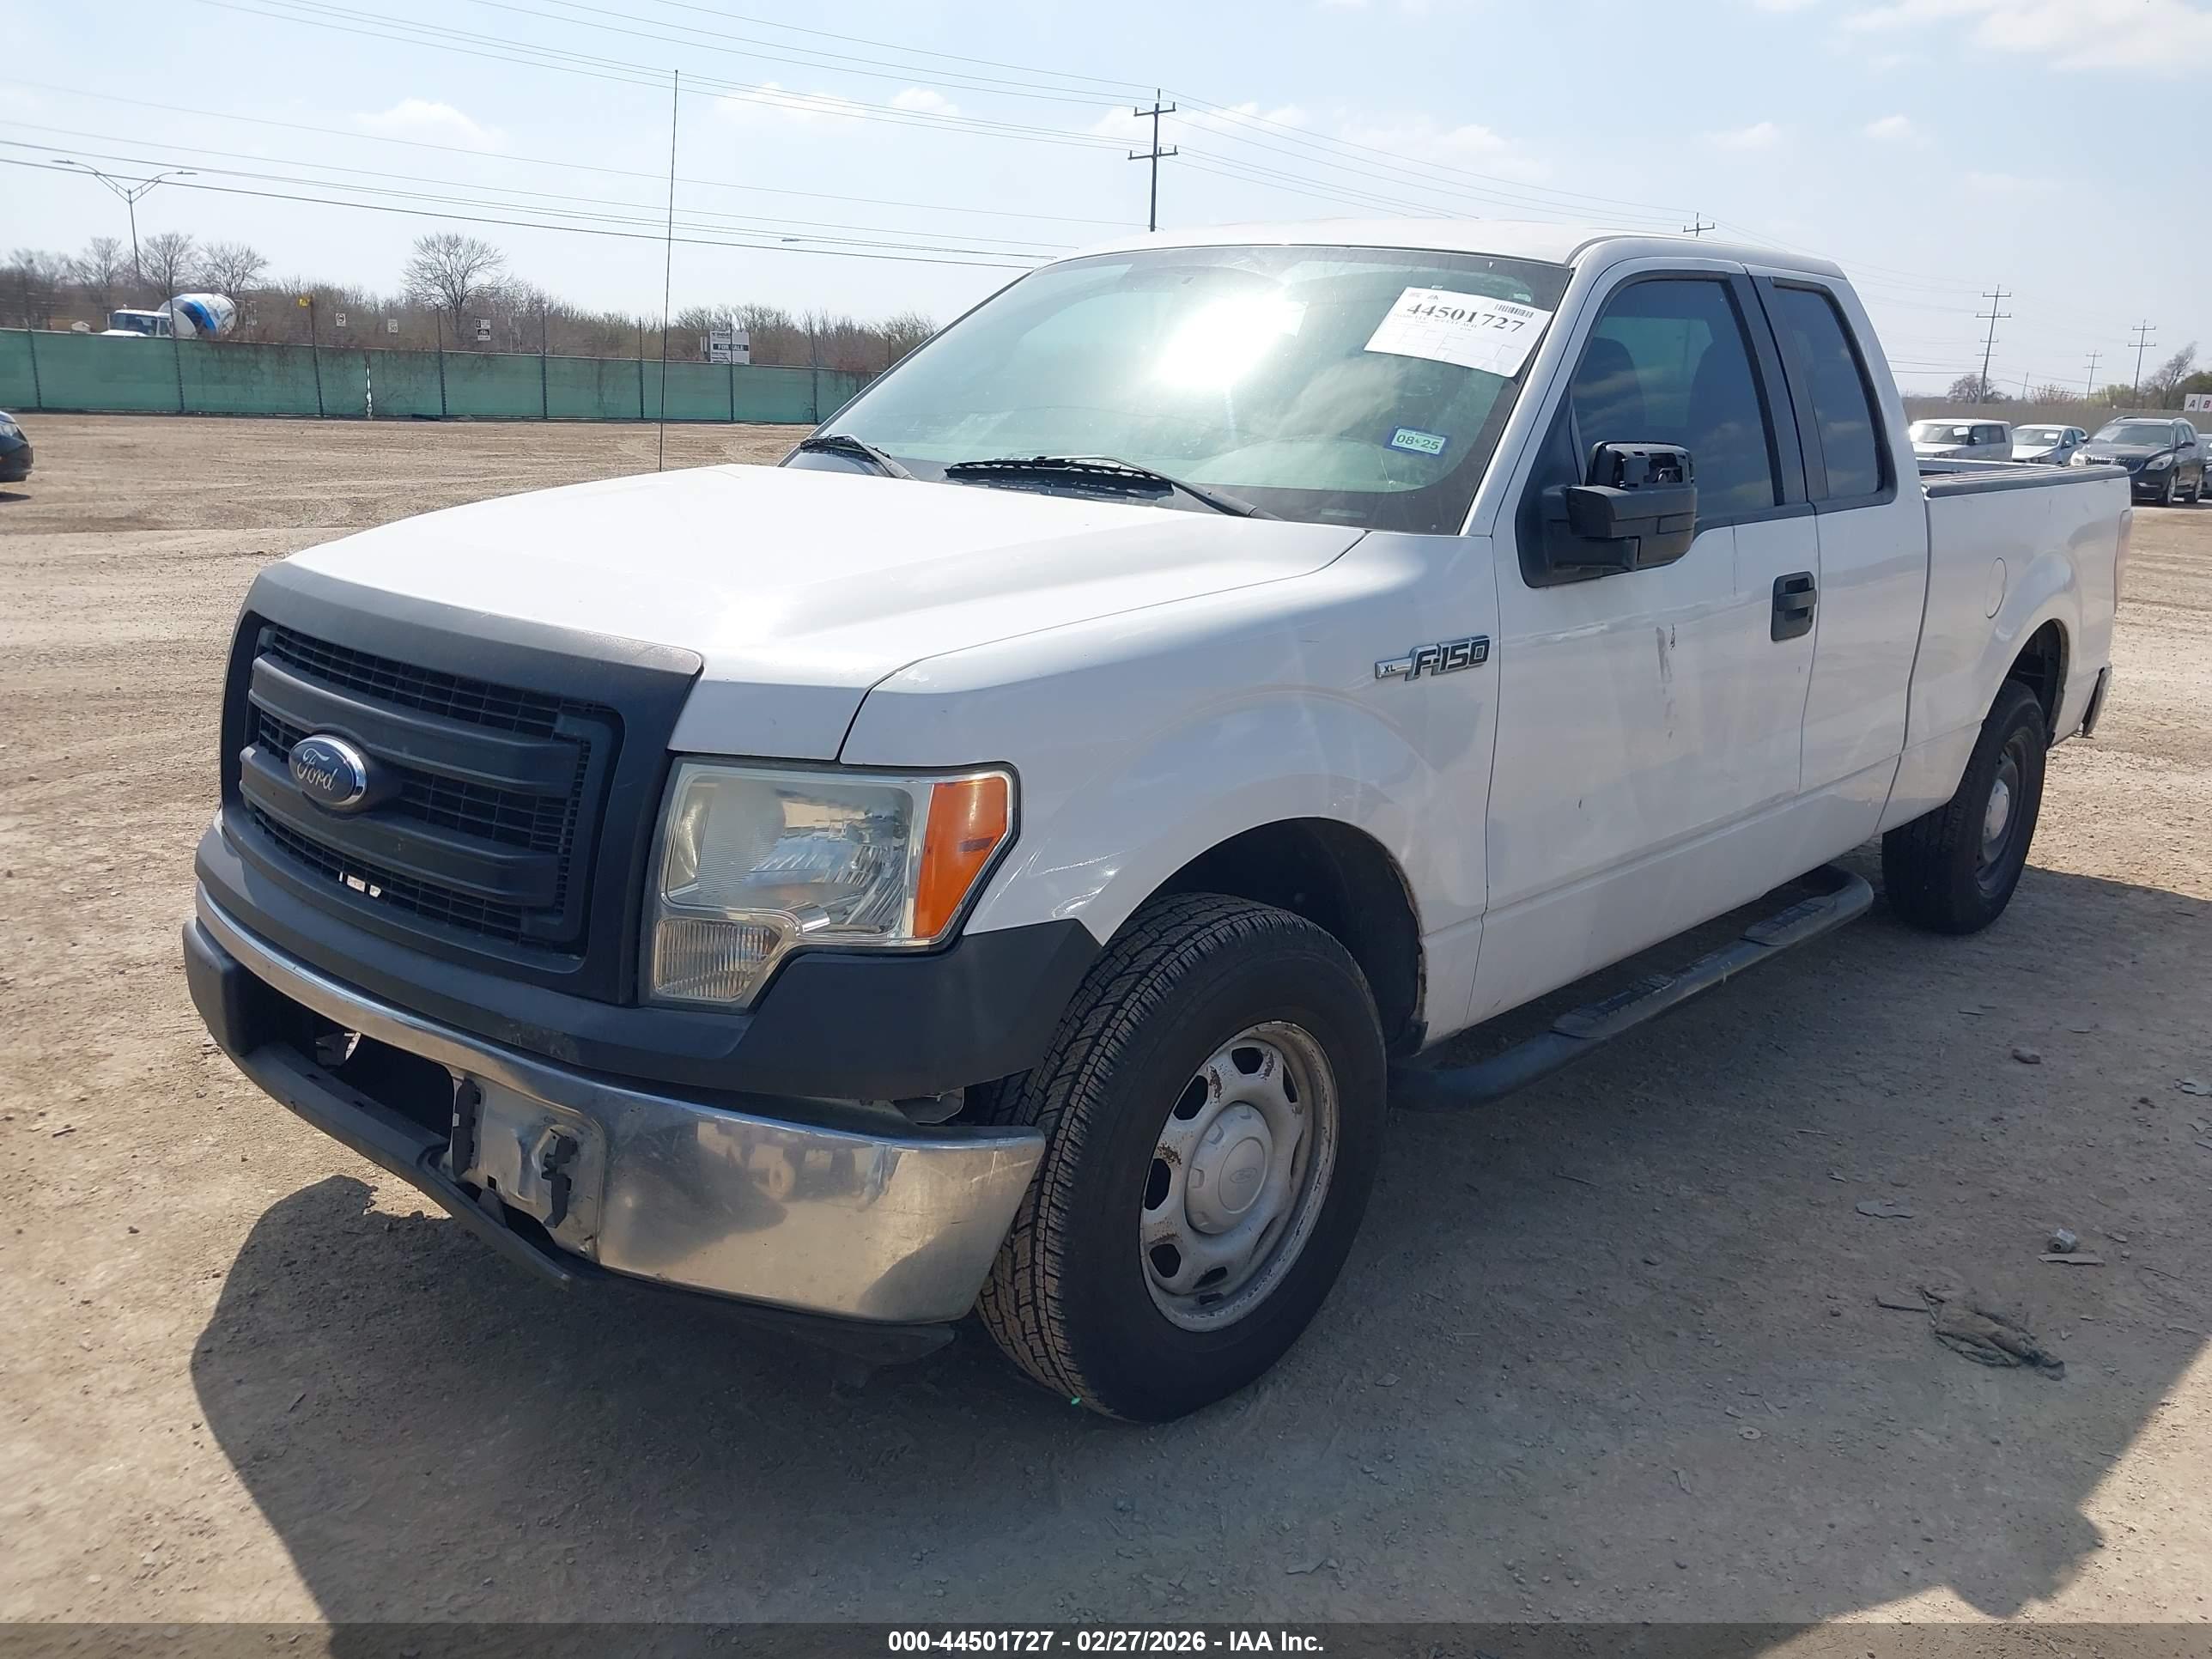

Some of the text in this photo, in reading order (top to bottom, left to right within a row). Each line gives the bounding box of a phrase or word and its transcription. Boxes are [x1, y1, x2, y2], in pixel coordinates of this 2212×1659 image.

[1407, 303, 1526, 333] 44501727
[2187, 399, 2196, 408] A
[2203, 399, 2211, 409] B
[1383, 665, 1396, 673] XL
[296, 748, 338, 791] Ford
